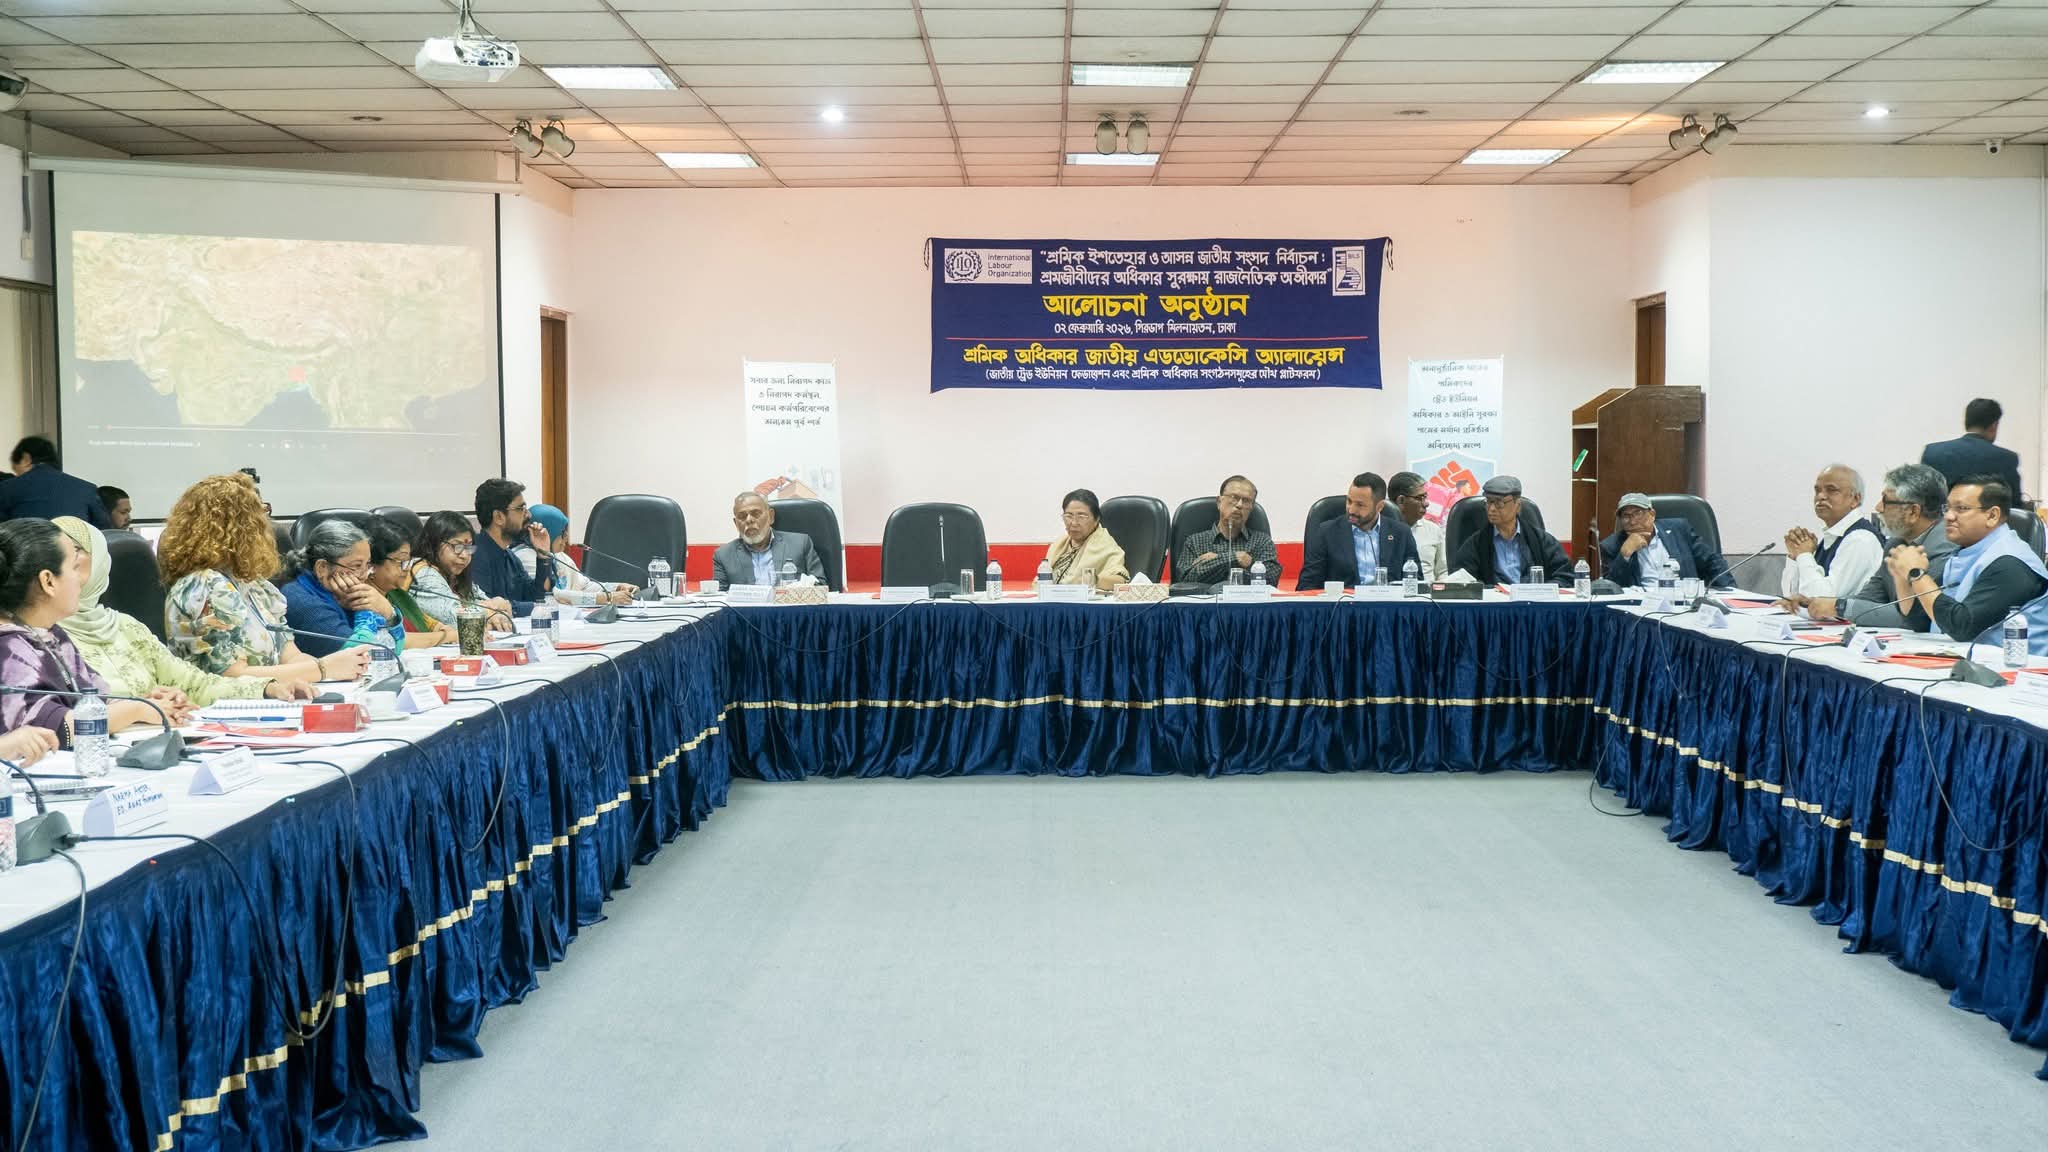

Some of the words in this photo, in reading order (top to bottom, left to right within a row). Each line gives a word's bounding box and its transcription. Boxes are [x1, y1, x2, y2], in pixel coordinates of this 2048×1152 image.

[987, 253, 1031, 262] International
[1088, 247, 1146, 265] ইশতেহার
[1149, 252, 1159, 264] ও
[1162, 251, 1194, 265] আসন্ন
[1198, 245, 1231, 266] জাতীয়
[1236, 251, 1269, 266] সংসদ
[1276, 247, 1318, 265] নির্বাচন
[987, 262, 1013, 270] Labour
[987, 269, 1032, 279] Organization
[1039, 264, 1110, 286] শ্রমজীবীদের
[1113, 265, 1163, 286] অধিকার
[1166, 270, 1210, 290] সুরক্ষায়
[1213, 266, 1278, 285] রাজনৈতিক
[1042, 293, 1148, 317] আলোচনা
[1159, 286, 1250, 321] অনুষ্ঠান
[1054, 324, 1067, 335] ০২
[1217, 323, 1237, 334] ঢাকা
[963, 344, 1008, 364] শ্রমিক
[1014, 342, 1078, 365] অধিকার
[1085, 342, 1139, 366] জাতীয়
[1144, 342, 1248, 365] এডভোকেসি
[1256, 347, 1345, 366] অ্যালায়েন্স
[1112, 370, 1130, 380] এবং
[1131, 367, 1158, 380] শ্রমিক
[1162, 366, 1198, 379] অধিকার
